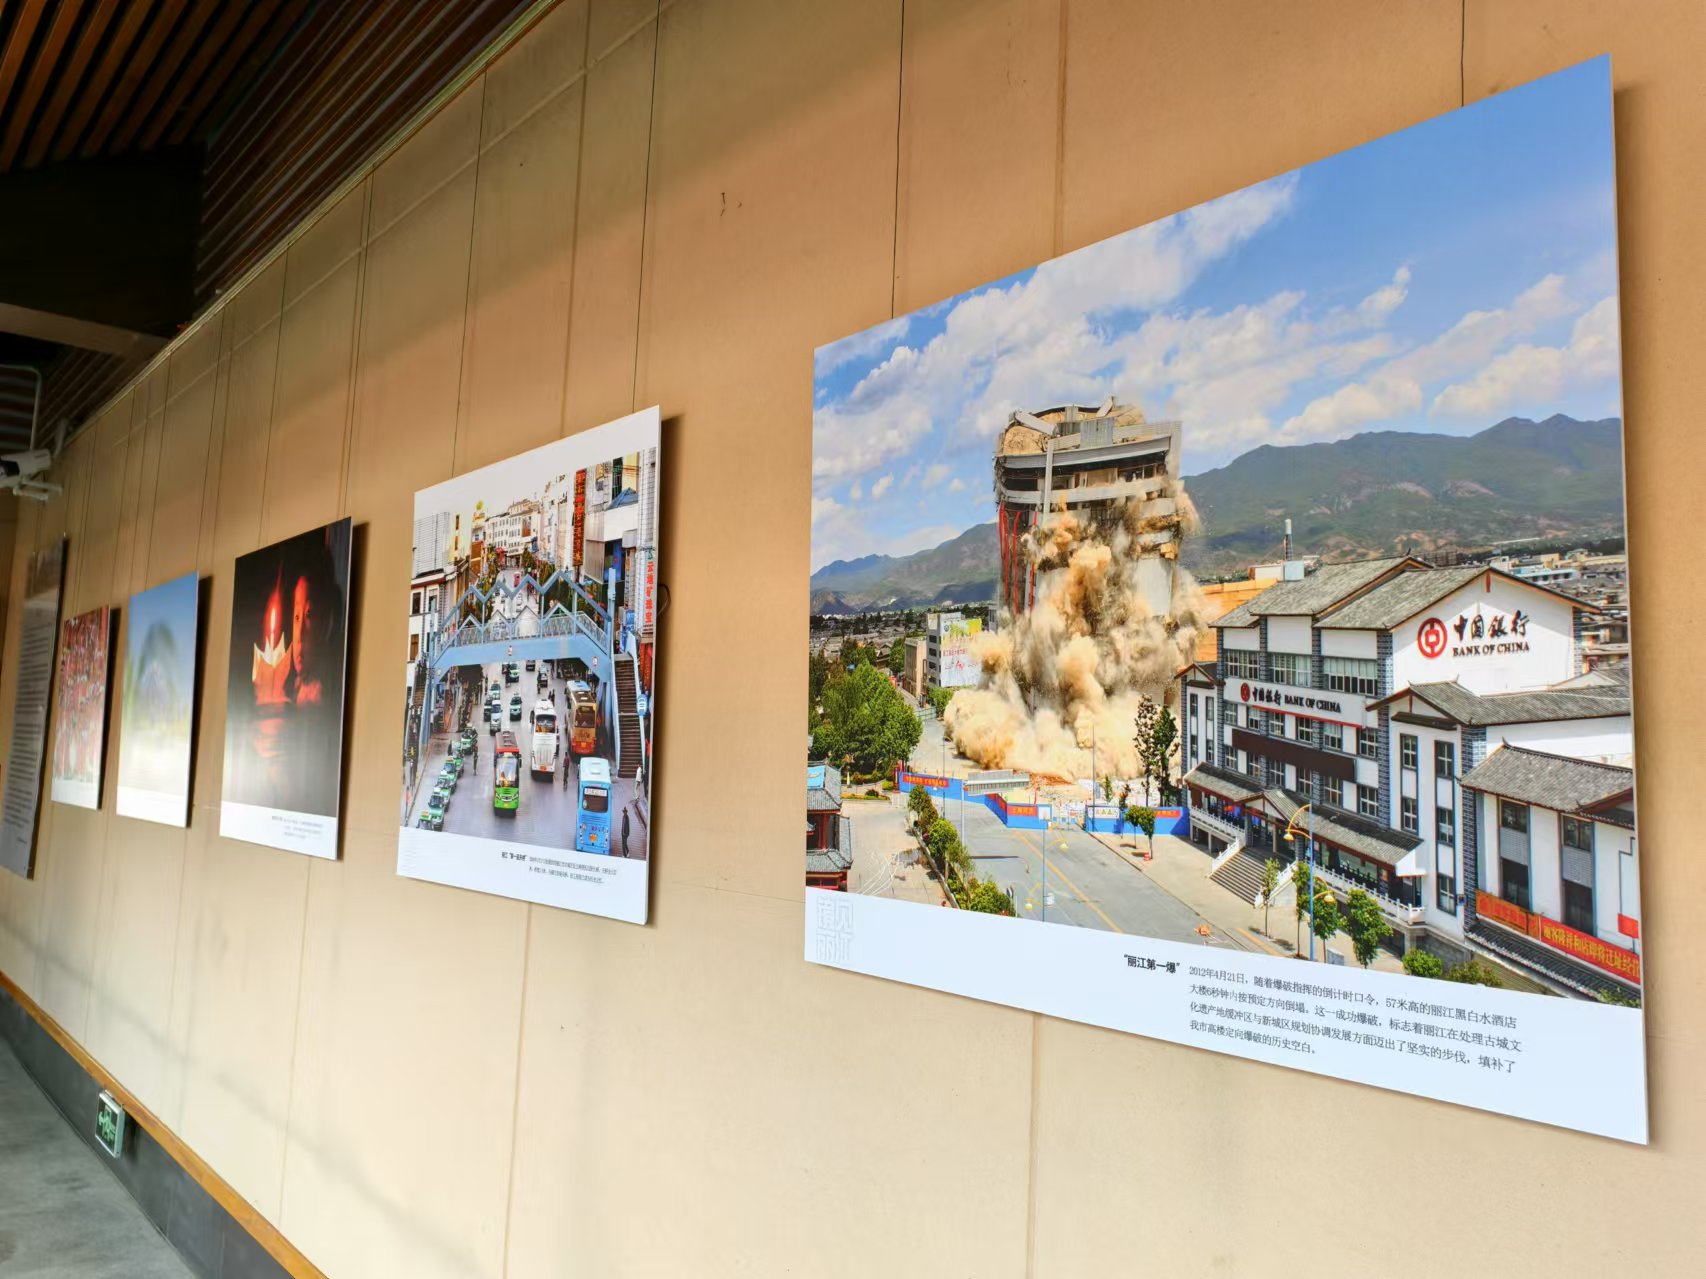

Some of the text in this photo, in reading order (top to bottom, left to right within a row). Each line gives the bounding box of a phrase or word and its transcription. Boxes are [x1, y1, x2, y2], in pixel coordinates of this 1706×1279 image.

[1453, 609, 1530, 641] 中国银行
[1452, 641, 1530, 657] BANK OF CHINA
[1284, 695, 1342, 713] BANK OF CHINA
